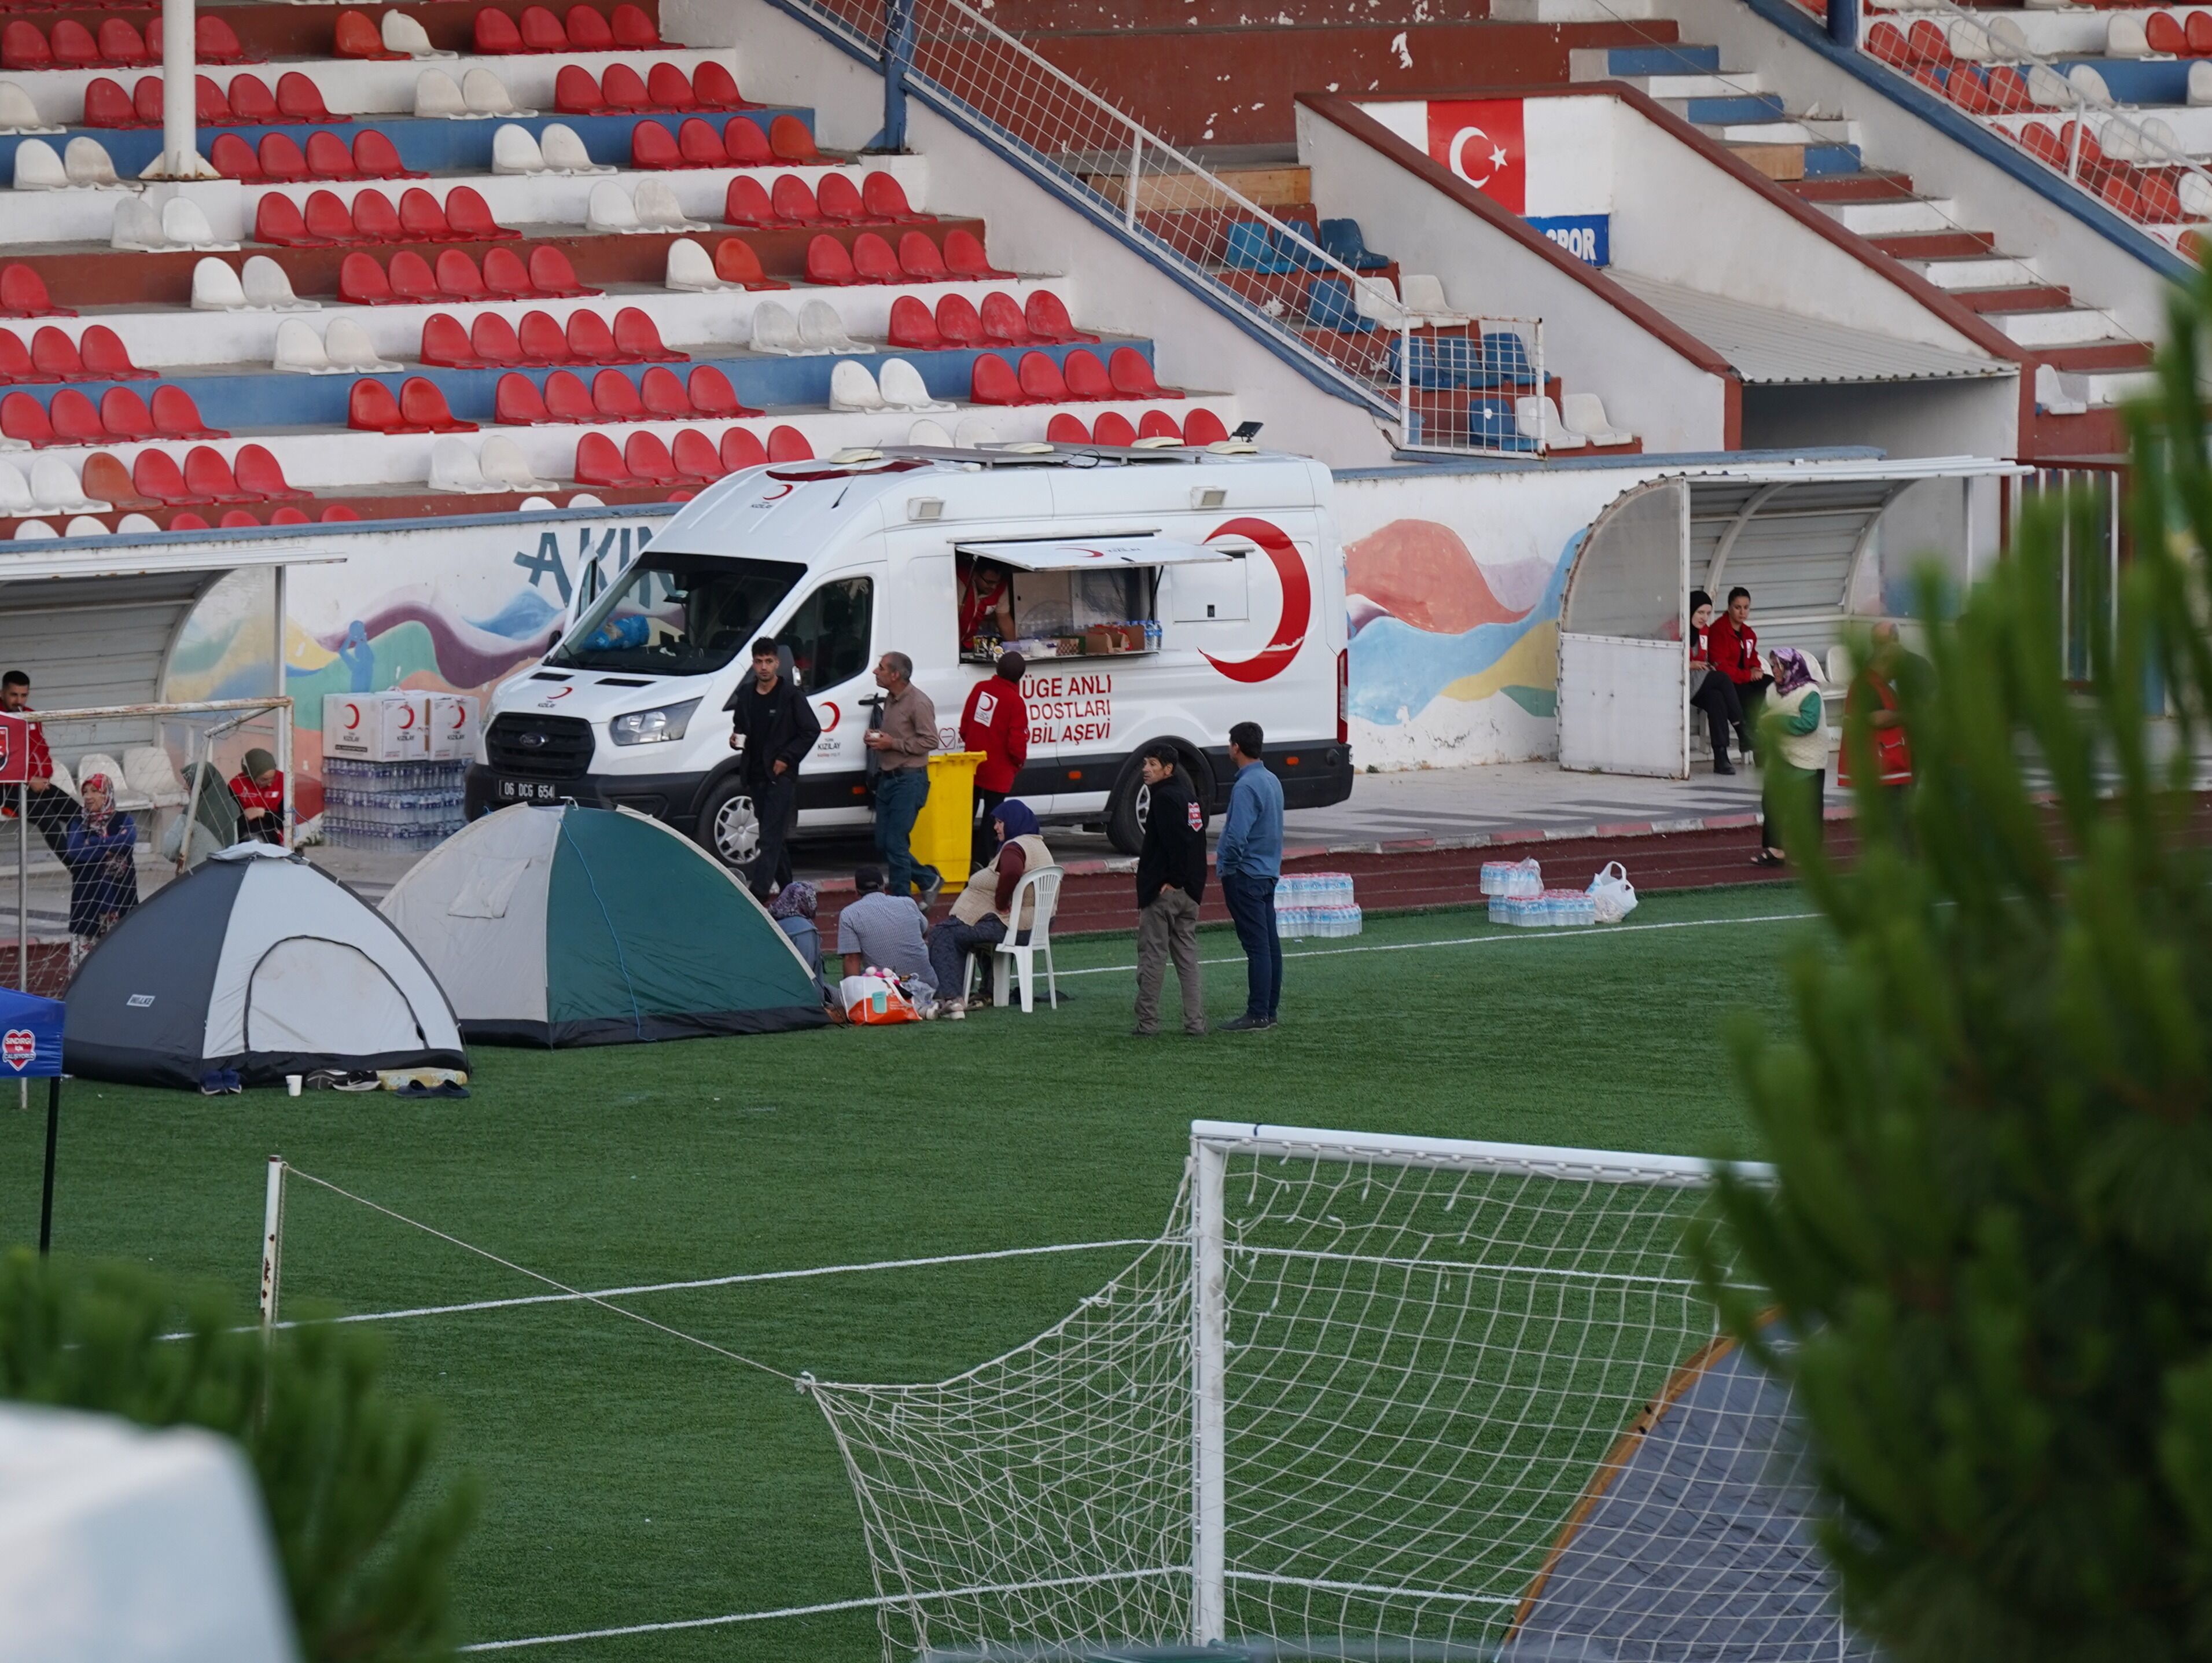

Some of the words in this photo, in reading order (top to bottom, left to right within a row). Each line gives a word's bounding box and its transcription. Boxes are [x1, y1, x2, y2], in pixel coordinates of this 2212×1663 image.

[1017, 674, 1062, 699] ÜGE
[1068, 674, 1111, 696] ANLI
[1029, 699, 1110, 720] DOSTLARI
[1027, 722, 1057, 744] BİL
[1061, 718, 1110, 746] AŞEVİ
[818, 742, 841, 750] KIZILAY
[505, 782, 514, 796] 06
[518, 783, 533, 797] DCG
[538, 785, 554, 799] 654
